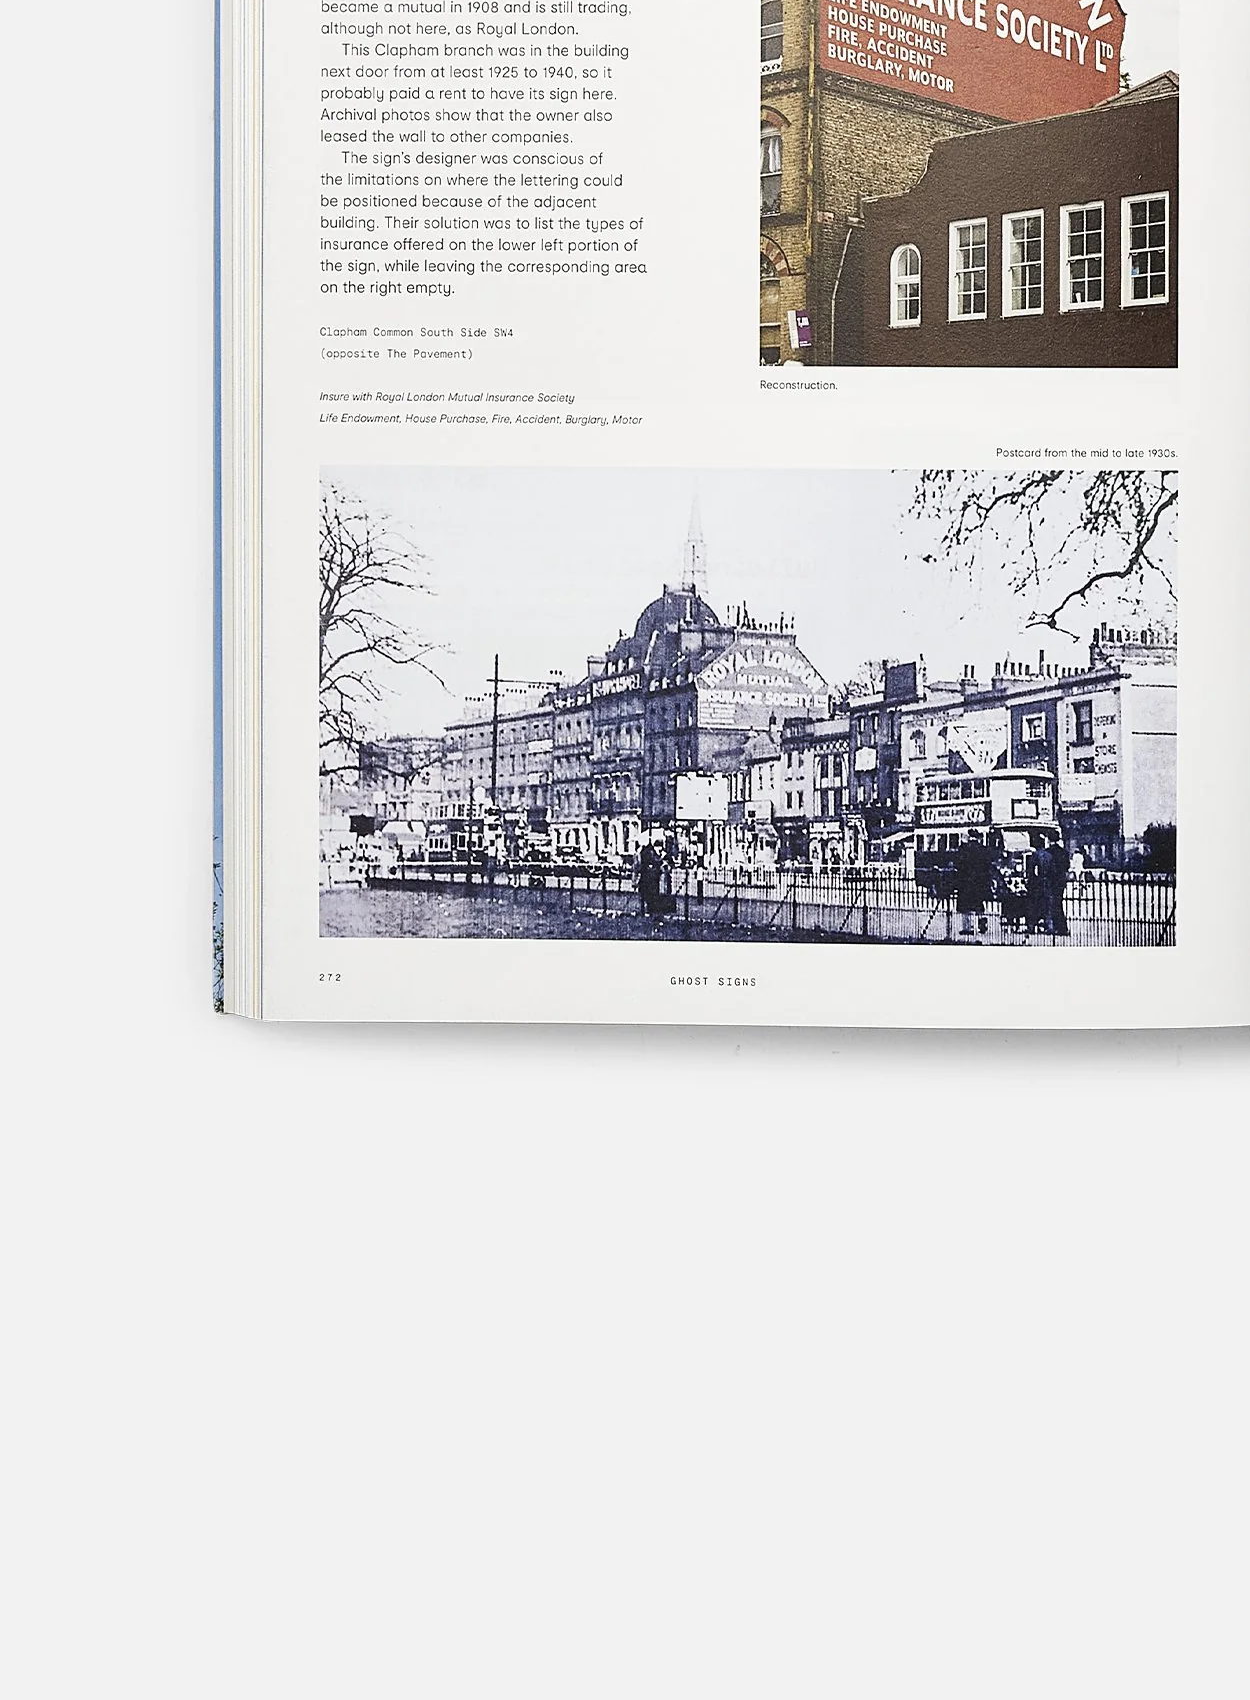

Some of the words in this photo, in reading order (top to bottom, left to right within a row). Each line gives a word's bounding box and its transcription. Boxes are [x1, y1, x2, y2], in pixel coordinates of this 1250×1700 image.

[321, 0, 379, 13] became
[383, 3, 394, 14] a
[397, 0, 446, 14] mutual
[450, 0, 463, 13] in
[467, 1, 499, 14] 1908
[503, 0, 531, 14] and
[535, 0, 547, 14] is
[550, 0, 573, 14] still
[577, 0, 632, 18] trading,
[828, 5, 874, 33] HOUSE
[879, 22, 948, 57] PURCHASE
[996, 2, 1089, 66] SOCIETY
[828, 25, 862, 51] FIRE,
[867, 37, 934, 69] ACCIDENT
[320, 66, 351, 78] next
[355, 64, 390, 78] door
[392, 64, 426, 79] from
[430, 66, 446, 79] at
[449, 65, 484, 79] least
[488, 65, 519, 79] 1925
[523, 66, 538, 79] to
[542, 66, 578, 80] 1940,
[582, 68, 599, 79] so
[603, 65, 613, 79] it
[828, 42, 906, 81] BURGLARY,
[908, 69, 955, 93] MOTOR
[320, 172, 343, 186] the
[347, 172, 420, 186] limitations
[424, 175, 442, 186] on
[446, 173, 489, 187] where
[493, 173, 516, 187] the
[520, 173, 579, 190] lettering
[583, 173, 623, 187] could
[320, 283, 338, 294] on
[342, 280, 366, 294] the
[370, 280, 402, 297] right
[406, 282, 455, 298] empty.
[319, 326, 368, 337] Clapham
[373, 326, 414, 337] Common
[420, 326, 454, 338] South
[460, 327, 487, 338] Side
[493, 327, 514, 338] SW4
[321, 347, 380, 360] (opposite
[386, 348, 407, 359] The
[413, 348, 473, 361] Pavement)
[759, 379, 838, 391] Reconstruction.
[319, 391, 350, 402] Insure
[352, 391, 373, 402] with
[375, 391, 405, 404] Royal
[406, 391, 445, 402] London
[447, 392, 484, 403] Mutual
[485, 392, 535, 403] Insurance
[536, 392, 576, 405] Society
[319, 412, 339, 423] Life
[340, 412, 402, 424] Endowment,
[404, 413, 438, 424] House
[439, 413, 489, 425] Purchase,
[491, 413, 513, 425] Fire,
[514, 414, 562, 425] Accident,
[564, 414, 609, 427] Burglary,
[611, 414, 644, 425] Motor
[996, 447, 1042, 458] Postcard
[1044, 447, 1068, 458] from
[1070, 448, 1088, 458] the
[1090, 448, 1109, 458] mid
[1111, 449, 1122, 459] to
[1125, 448, 1145, 458] late
[1148, 448, 1179, 459] 1930s.
[319, 972, 342, 982] 272
[670, 976, 709, 986] GHOST
[718, 976, 756, 987] SIGNS
